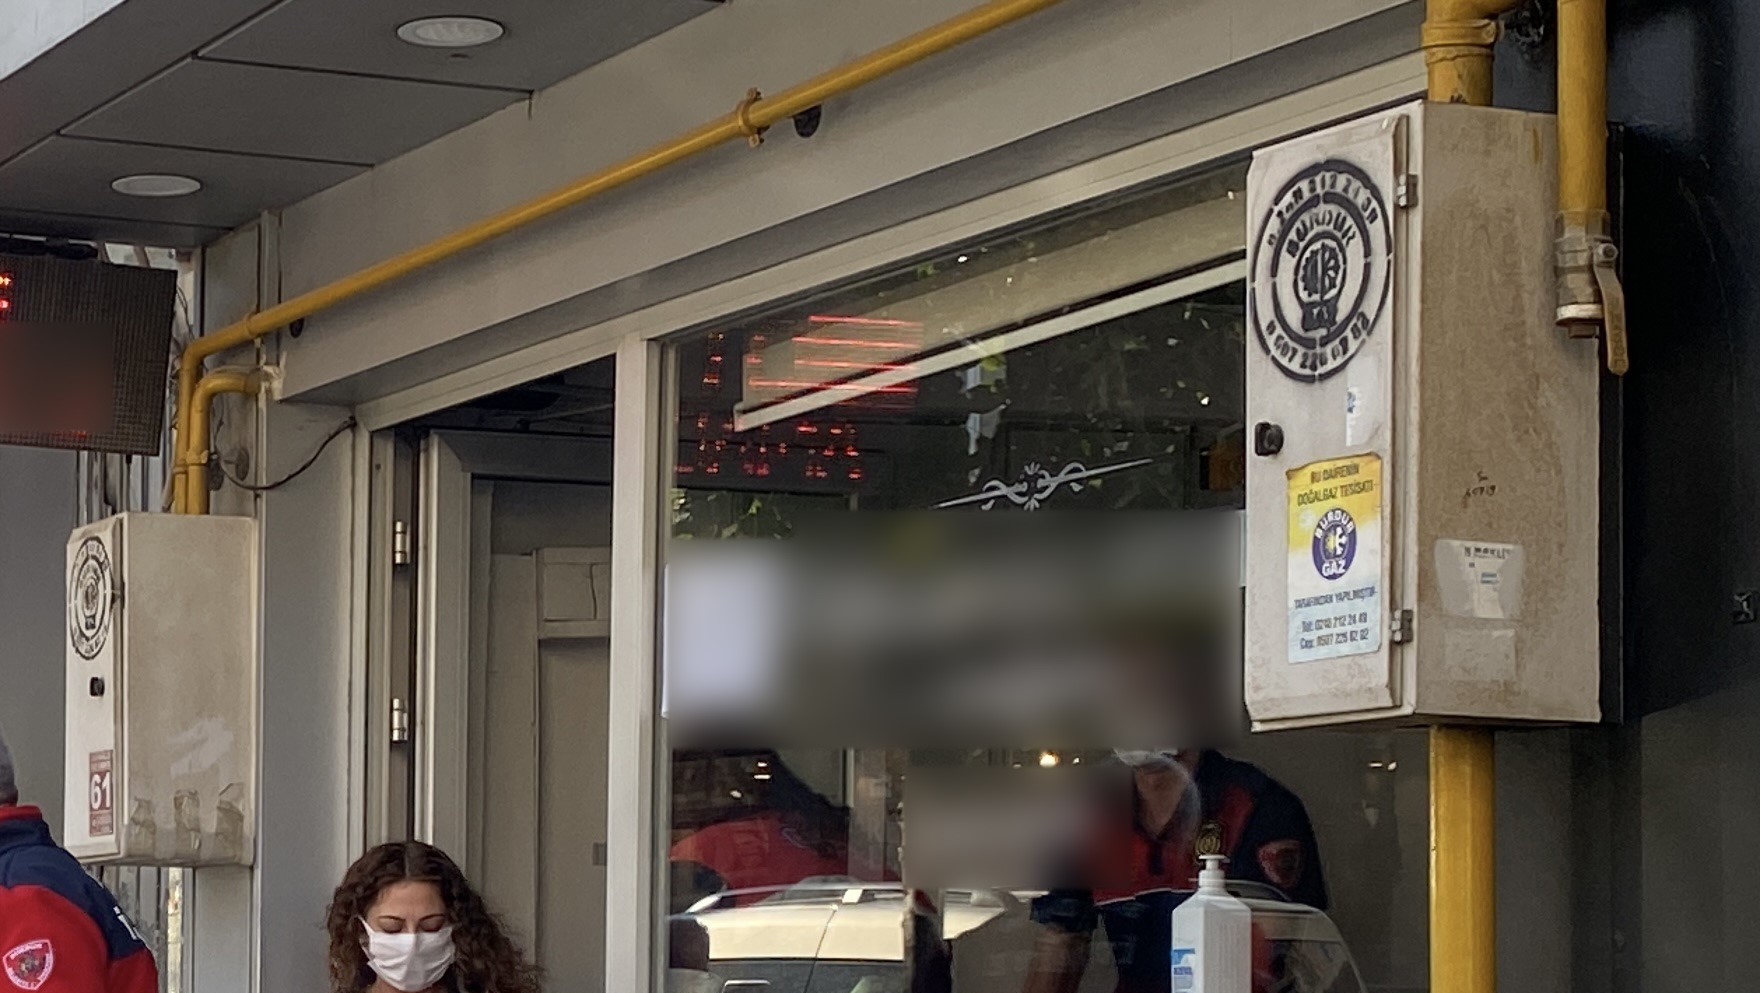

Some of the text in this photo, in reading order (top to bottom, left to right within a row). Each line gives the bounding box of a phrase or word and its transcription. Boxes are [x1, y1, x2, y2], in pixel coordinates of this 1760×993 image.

[1315, 510, 1355, 539] BURDUR
[1322, 559, 1346, 577] GAZ
[90, 771, 111, 810] 61
